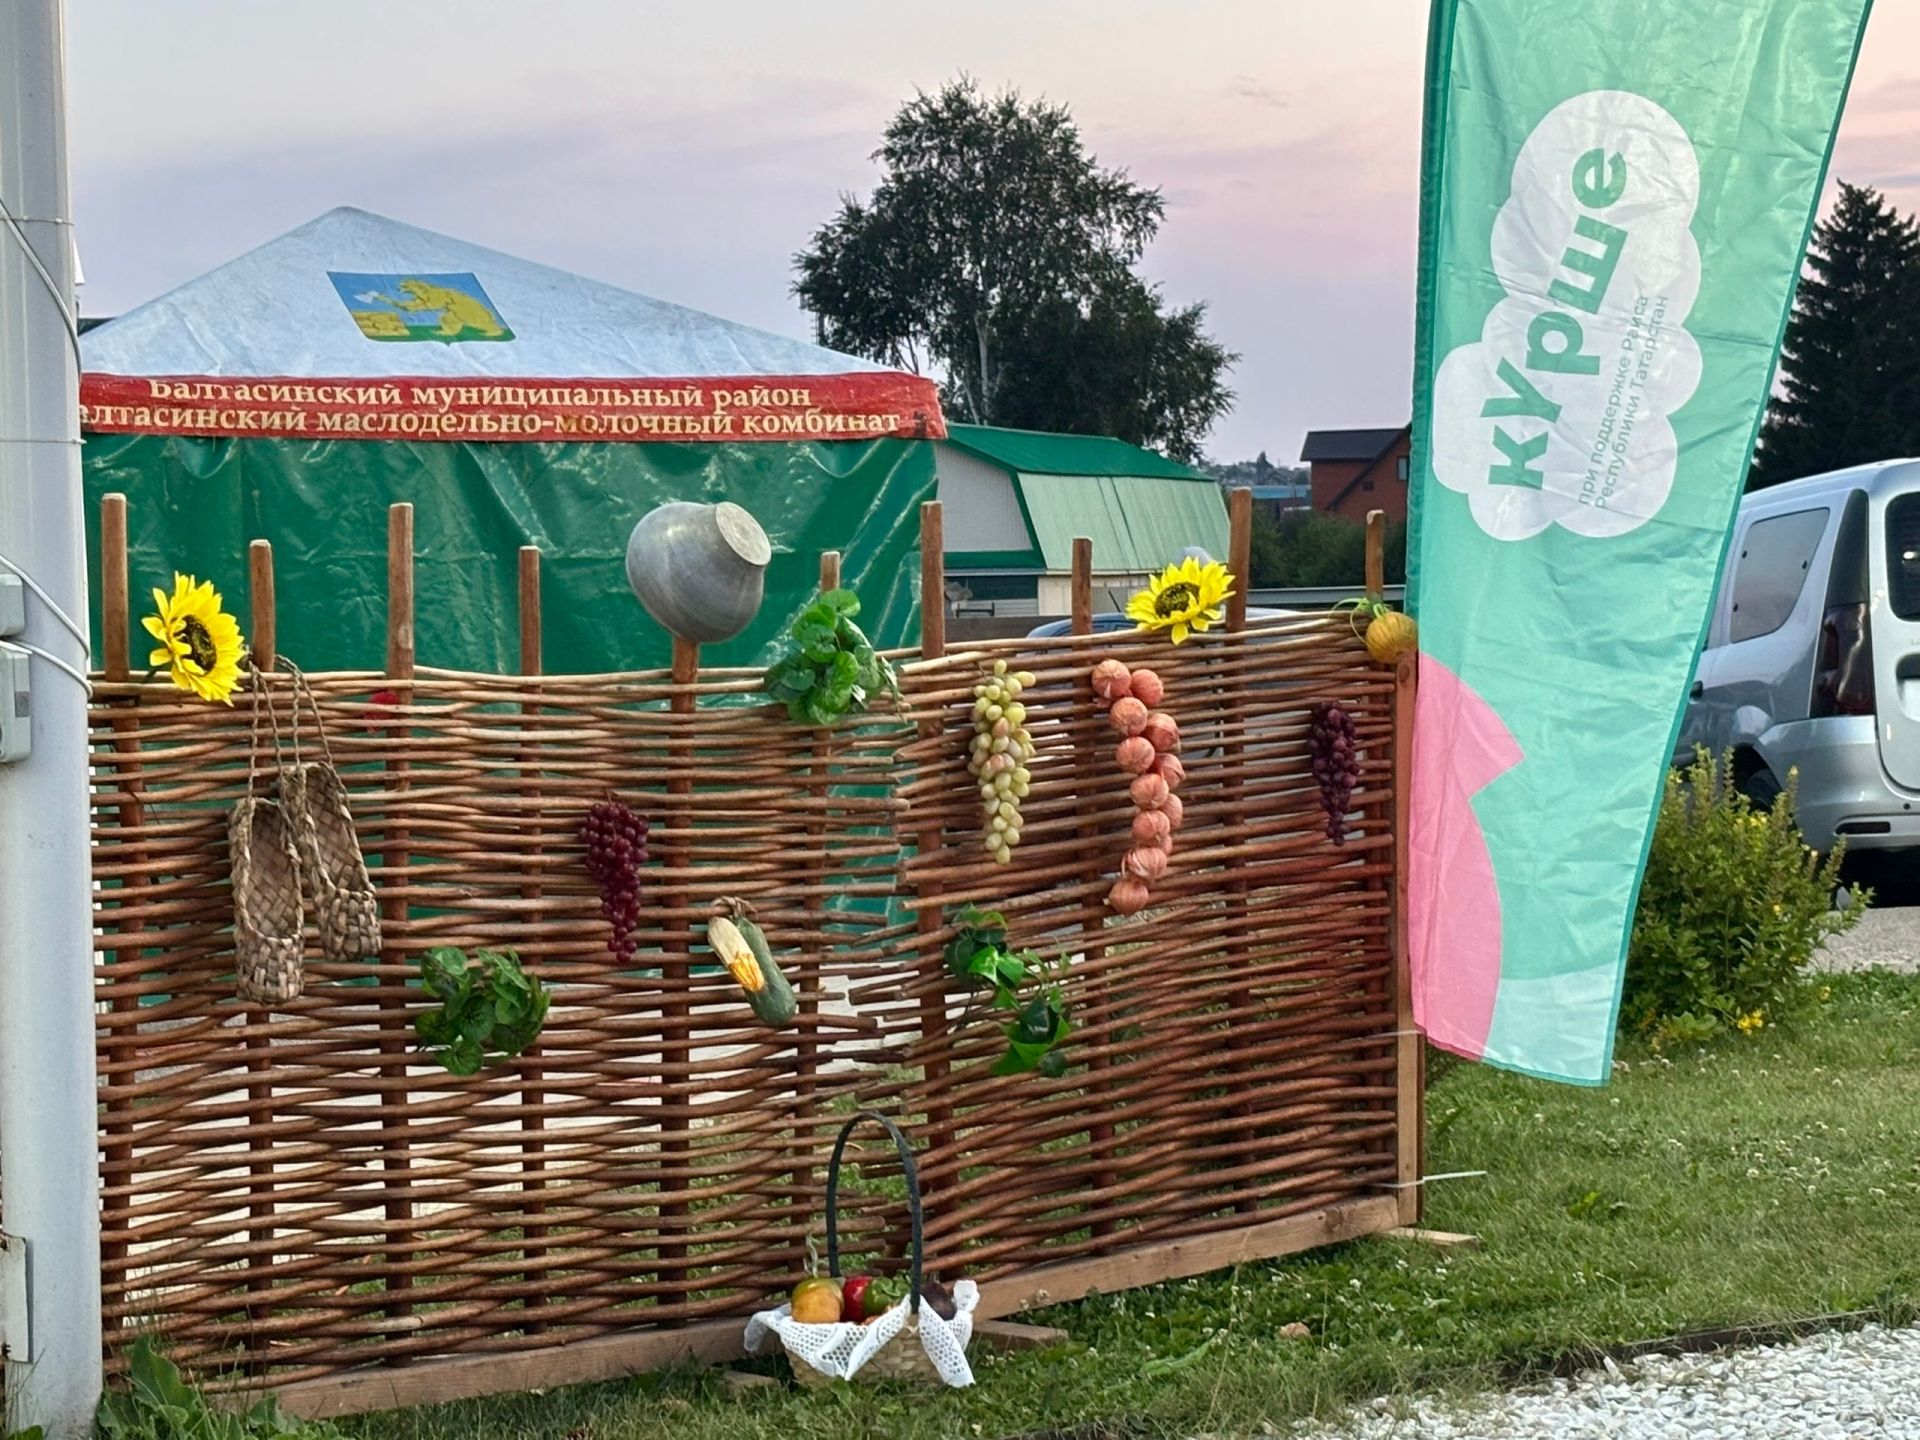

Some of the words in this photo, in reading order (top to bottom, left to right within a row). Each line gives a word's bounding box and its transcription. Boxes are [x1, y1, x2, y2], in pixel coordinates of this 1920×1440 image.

[79, 404, 307, 432] алтасинский
[741, 407, 901, 433] комбинат
[148, 379, 401, 405] Балтасинский
[411, 384, 701, 414] муниципальный
[710, 384, 812, 415] район
[1578, 467, 1598, 506] при
[1590, 357, 1631, 463] поддержке
[1621, 296, 1649, 352] Раиса
[1594, 396, 1641, 510] Республики
[1629, 295, 1669, 389] Татарстан
